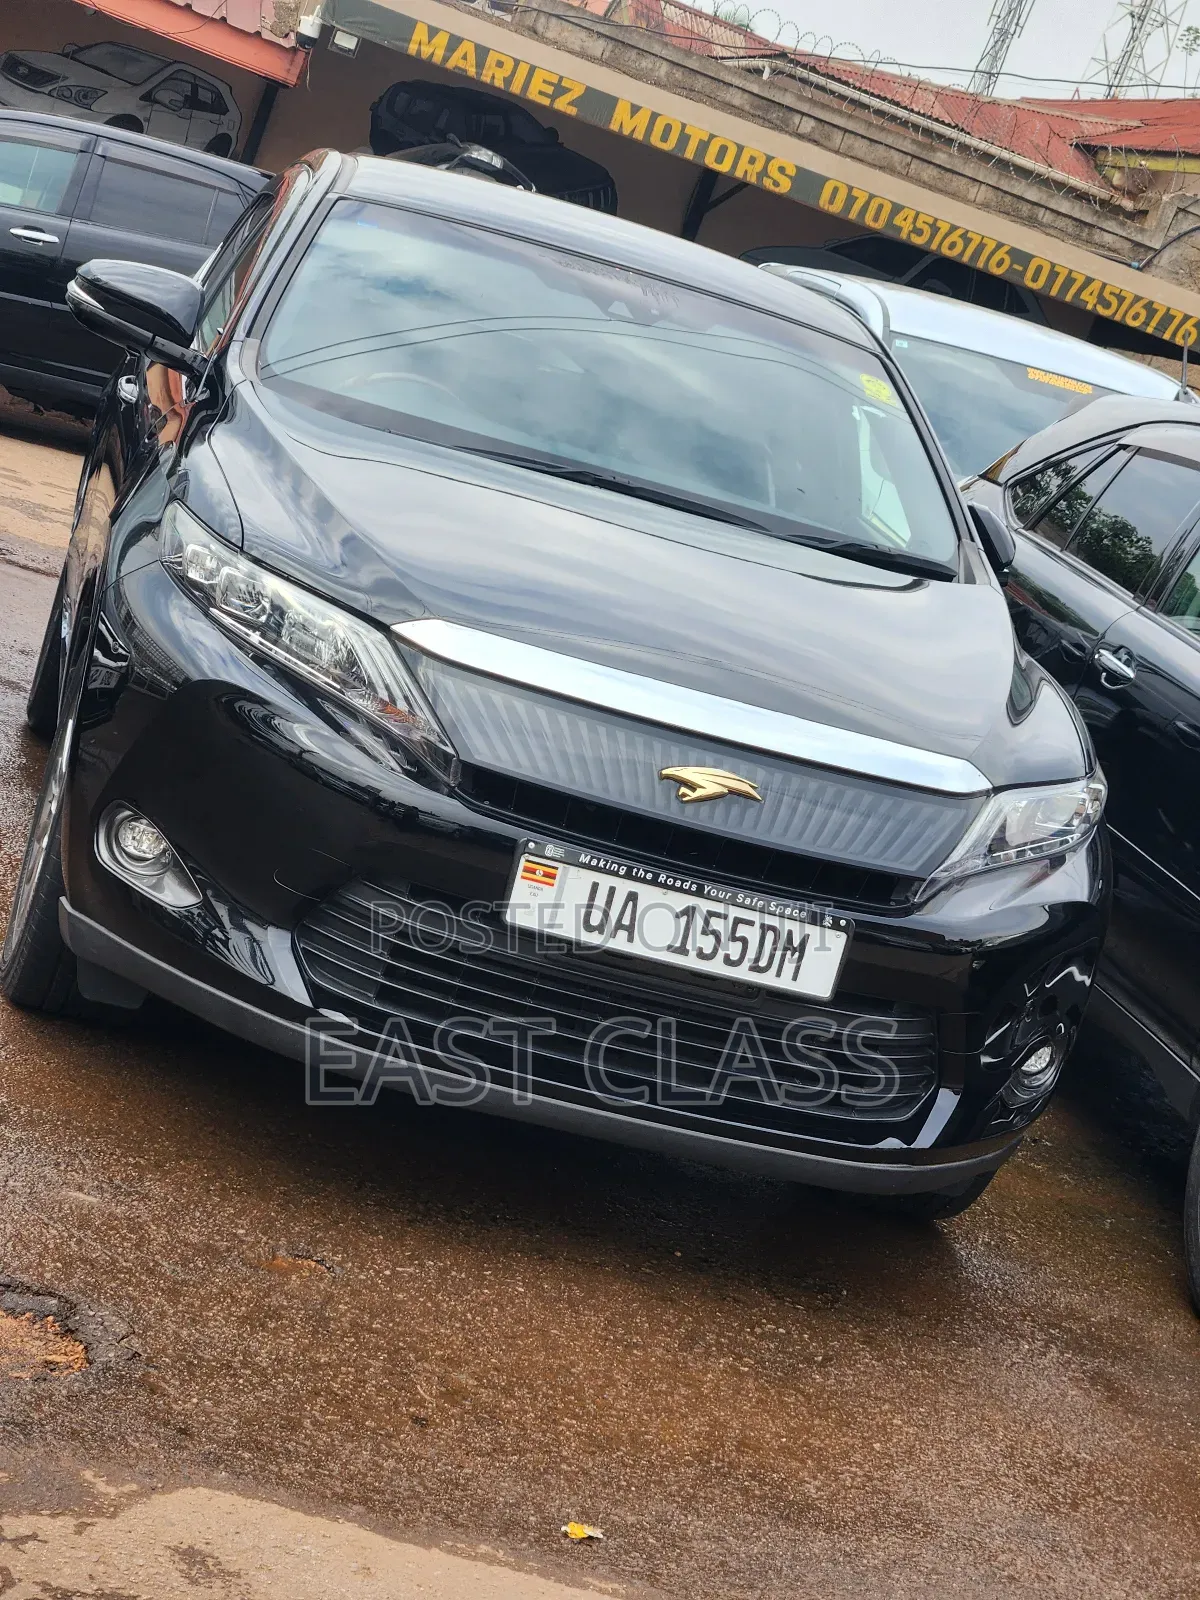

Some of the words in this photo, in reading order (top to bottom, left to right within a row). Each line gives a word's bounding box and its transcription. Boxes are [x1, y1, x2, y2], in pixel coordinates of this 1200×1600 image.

[407, 22, 587, 115] MARIEZ
[609, 99, 797, 194] MOTORS
[578, 853, 627, 876] Making
[631, 867, 654, 881] the
[657, 873, 698, 893] Roads
[703, 884, 733, 901] Your
[736, 893, 764, 908] Safe
[768, 904, 808, 919] Space
[582, 880, 639, 944] UA
[666, 904, 811, 982] 155DM
